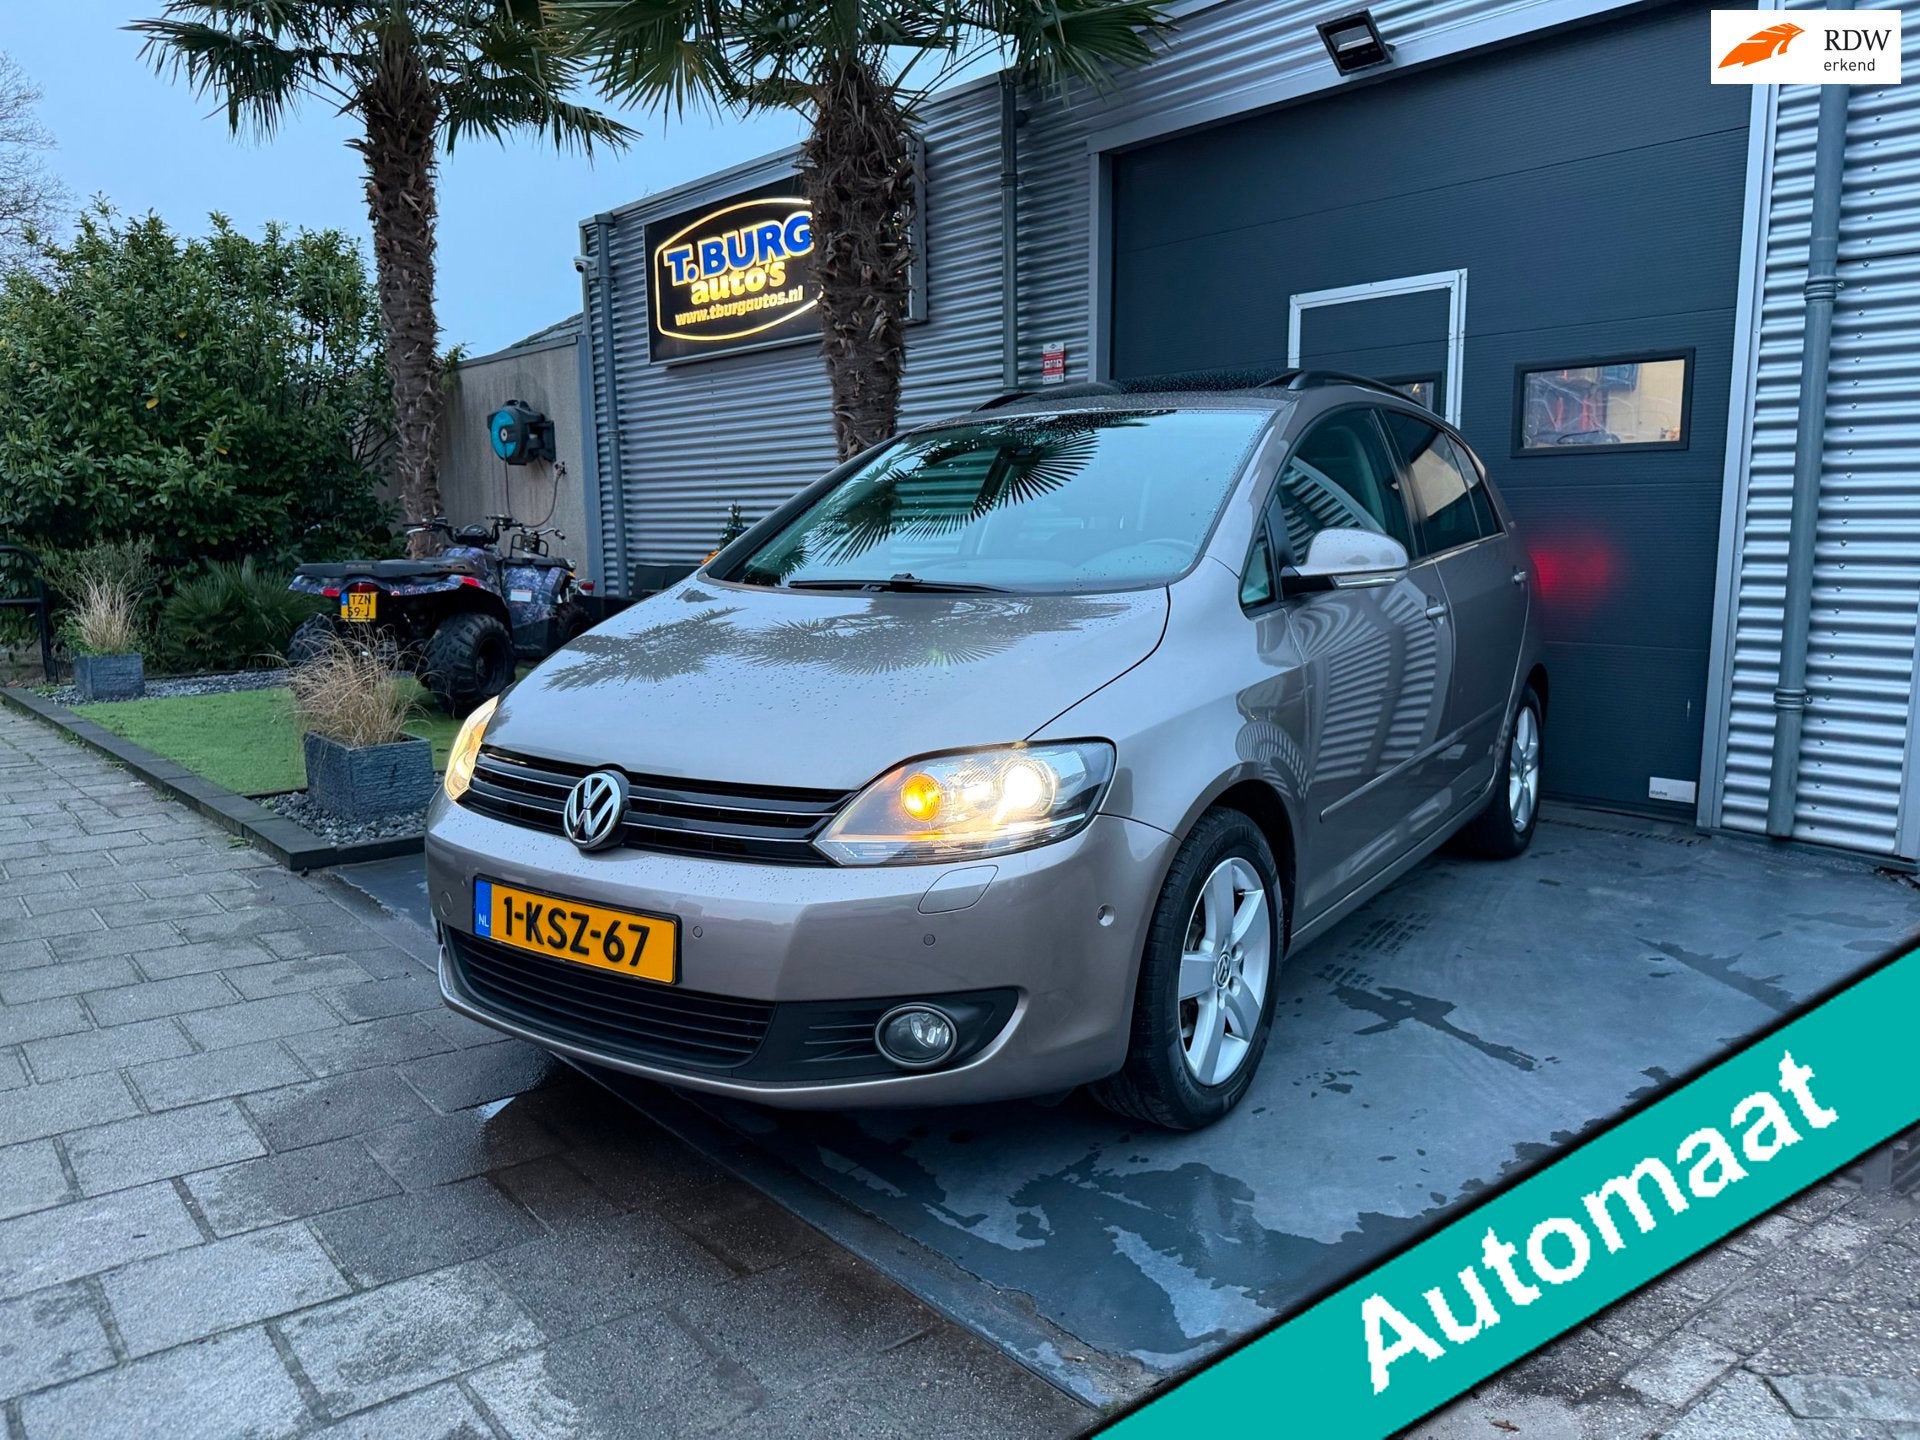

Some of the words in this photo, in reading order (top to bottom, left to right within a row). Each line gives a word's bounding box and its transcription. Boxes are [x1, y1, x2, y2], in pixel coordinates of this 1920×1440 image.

[664, 211, 815, 286] T.BURG
[691, 261, 786, 305] auto's
[675, 286, 804, 327] www.tburgautos.nl
[351, 595, 371, 605] TZN
[478, 913, 489, 927] NL
[503, 896, 650, 967] 1-KSZ-67
